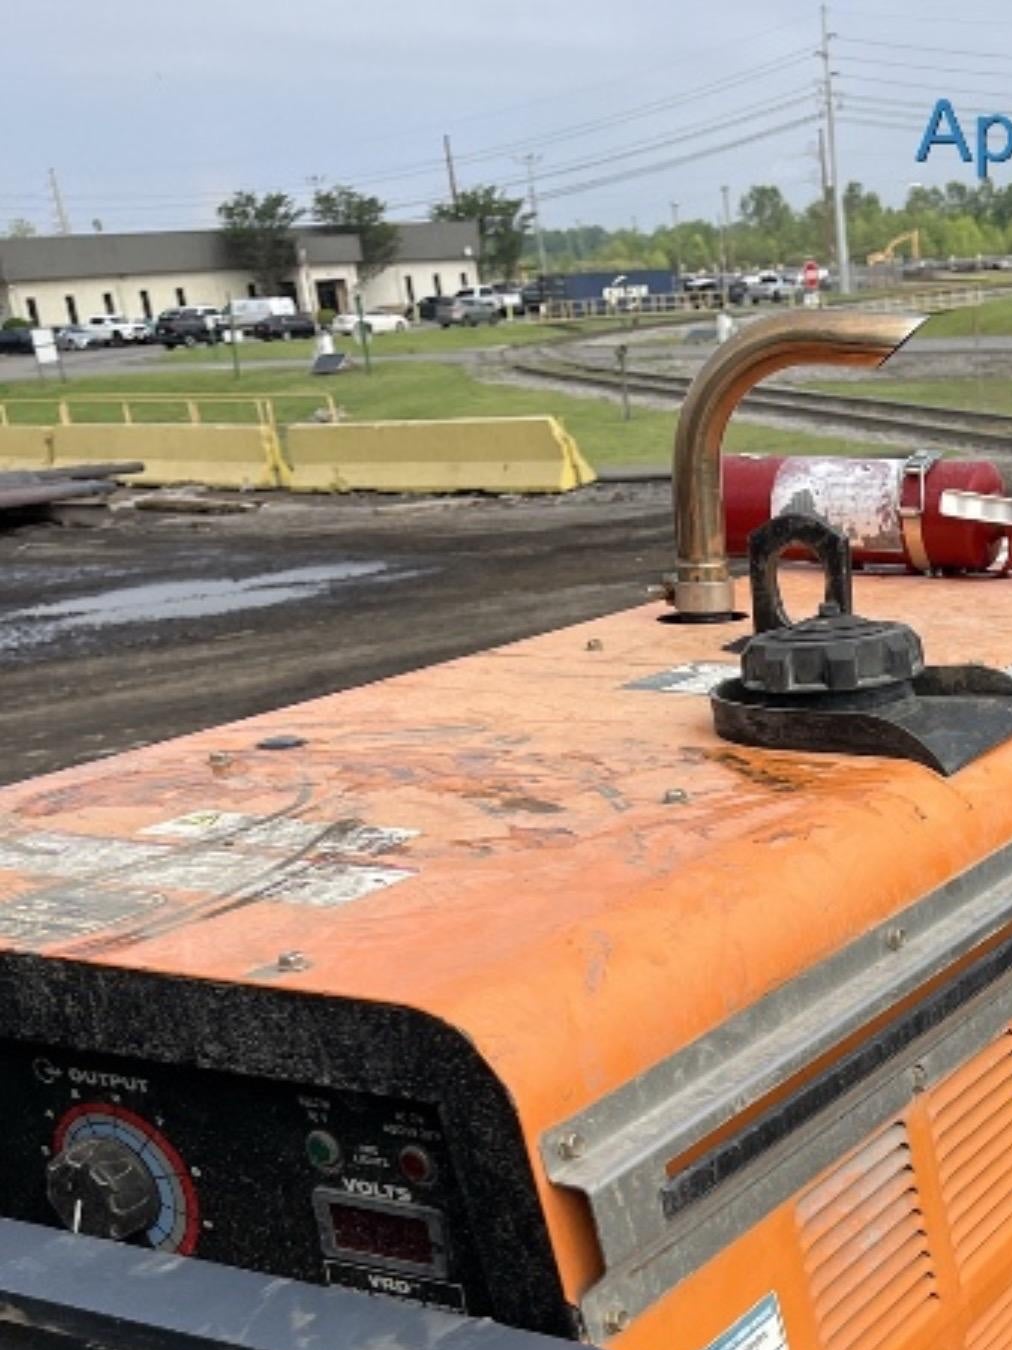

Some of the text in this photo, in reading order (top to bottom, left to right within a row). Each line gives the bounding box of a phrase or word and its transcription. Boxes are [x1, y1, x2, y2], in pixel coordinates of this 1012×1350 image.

[68, 1067, 149, 1093] OUTPUT
[341, 1176, 413, 1202] VOLTS
[368, 1274, 411, 1294] VRD
